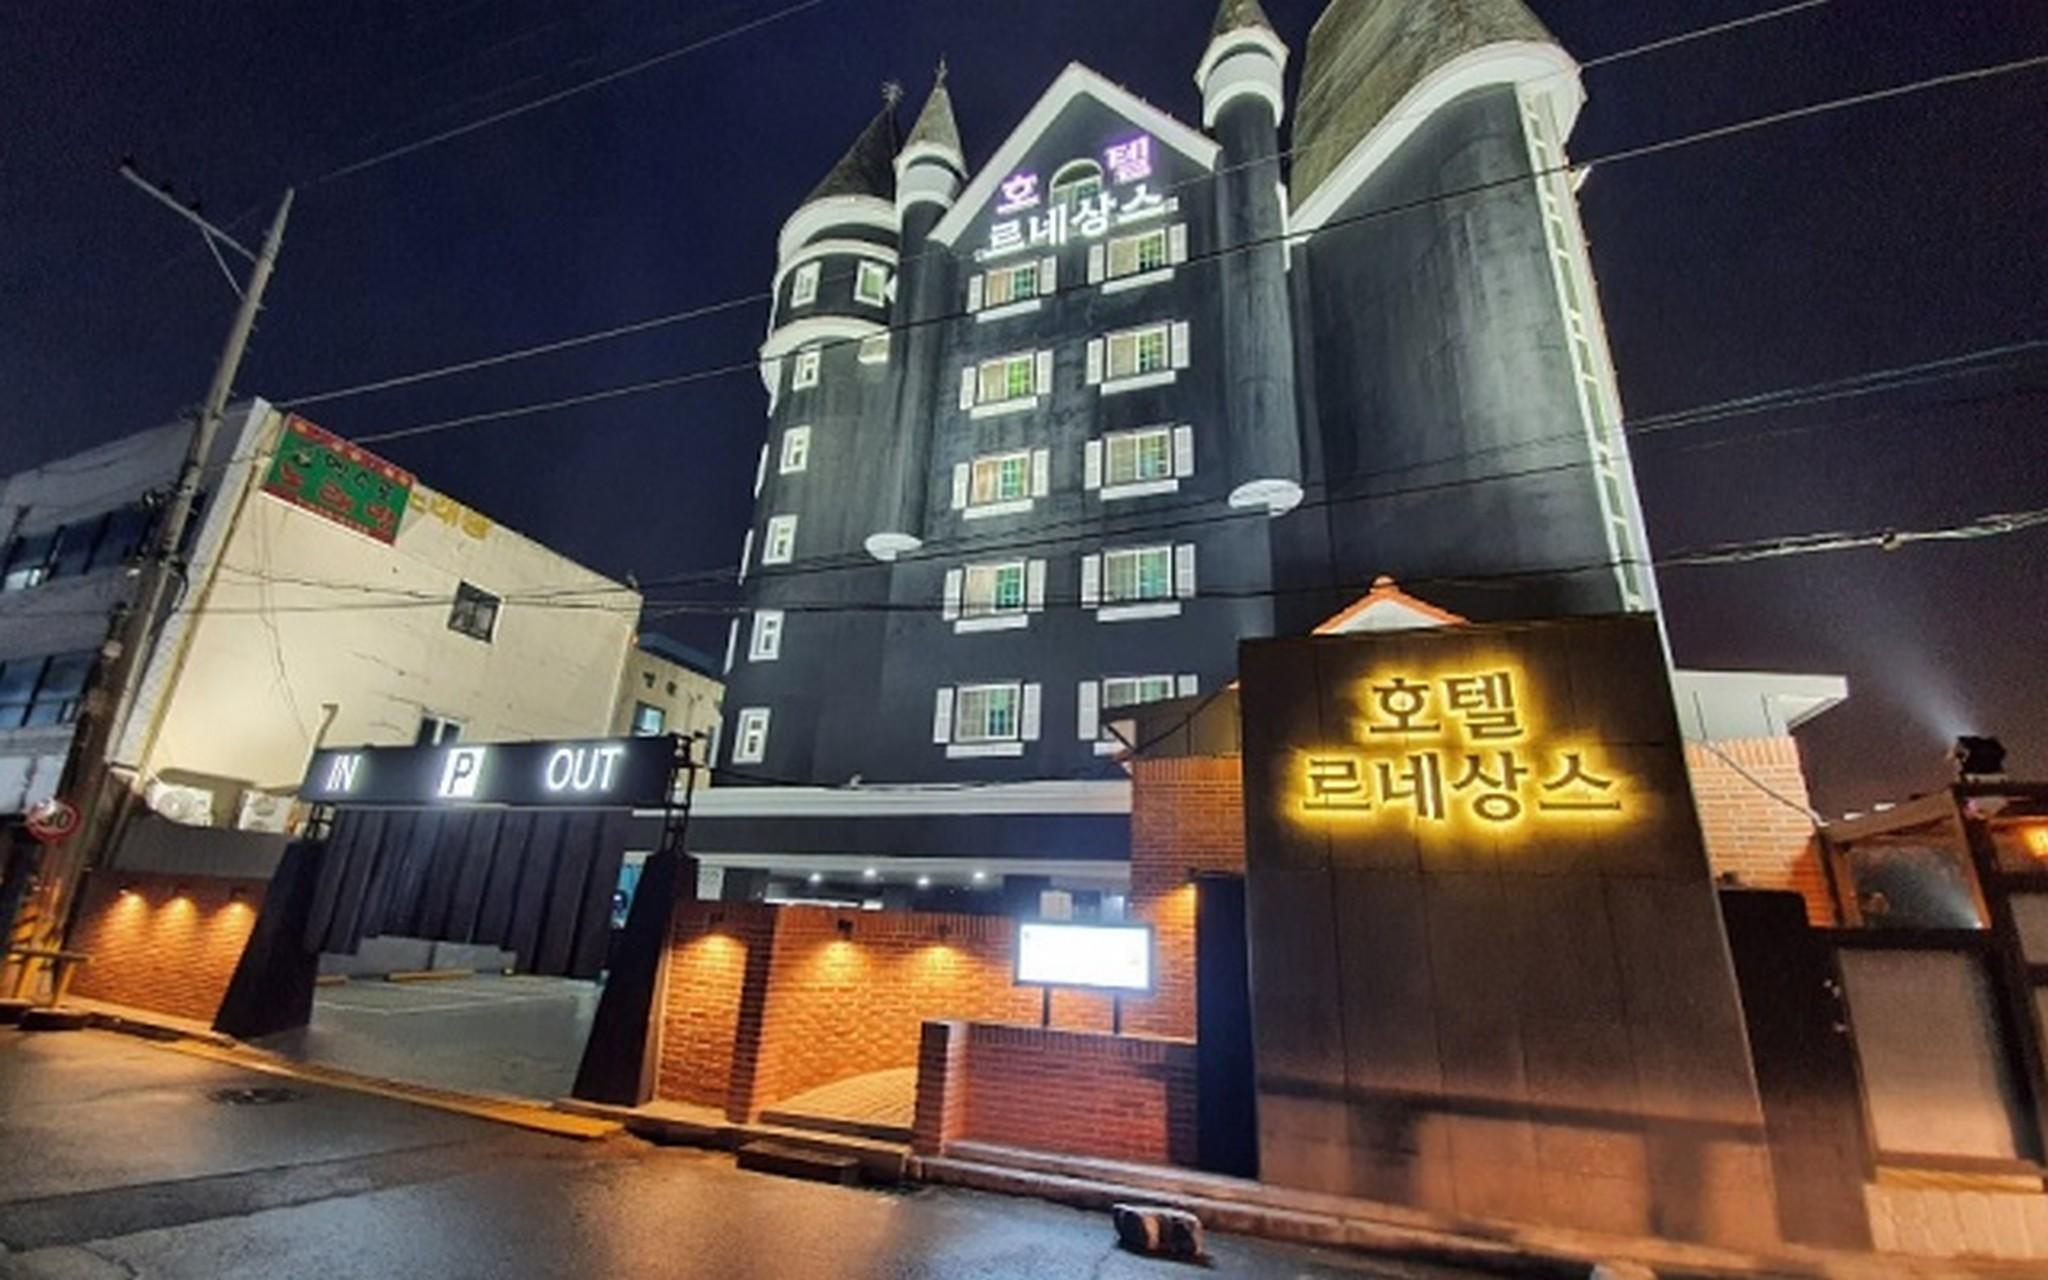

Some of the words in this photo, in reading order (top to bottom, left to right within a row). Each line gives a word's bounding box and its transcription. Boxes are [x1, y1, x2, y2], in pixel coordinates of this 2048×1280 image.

[996, 135, 1152, 215] 호텔
[986, 183, 1166, 252] 르네상스
[1369, 671, 1524, 740] 호텔
[325, 753, 363, 792] IN
[446, 751, 479, 796] P
[547, 747, 627, 791] OUT
[1302, 750, 1622, 820] 르네상스
